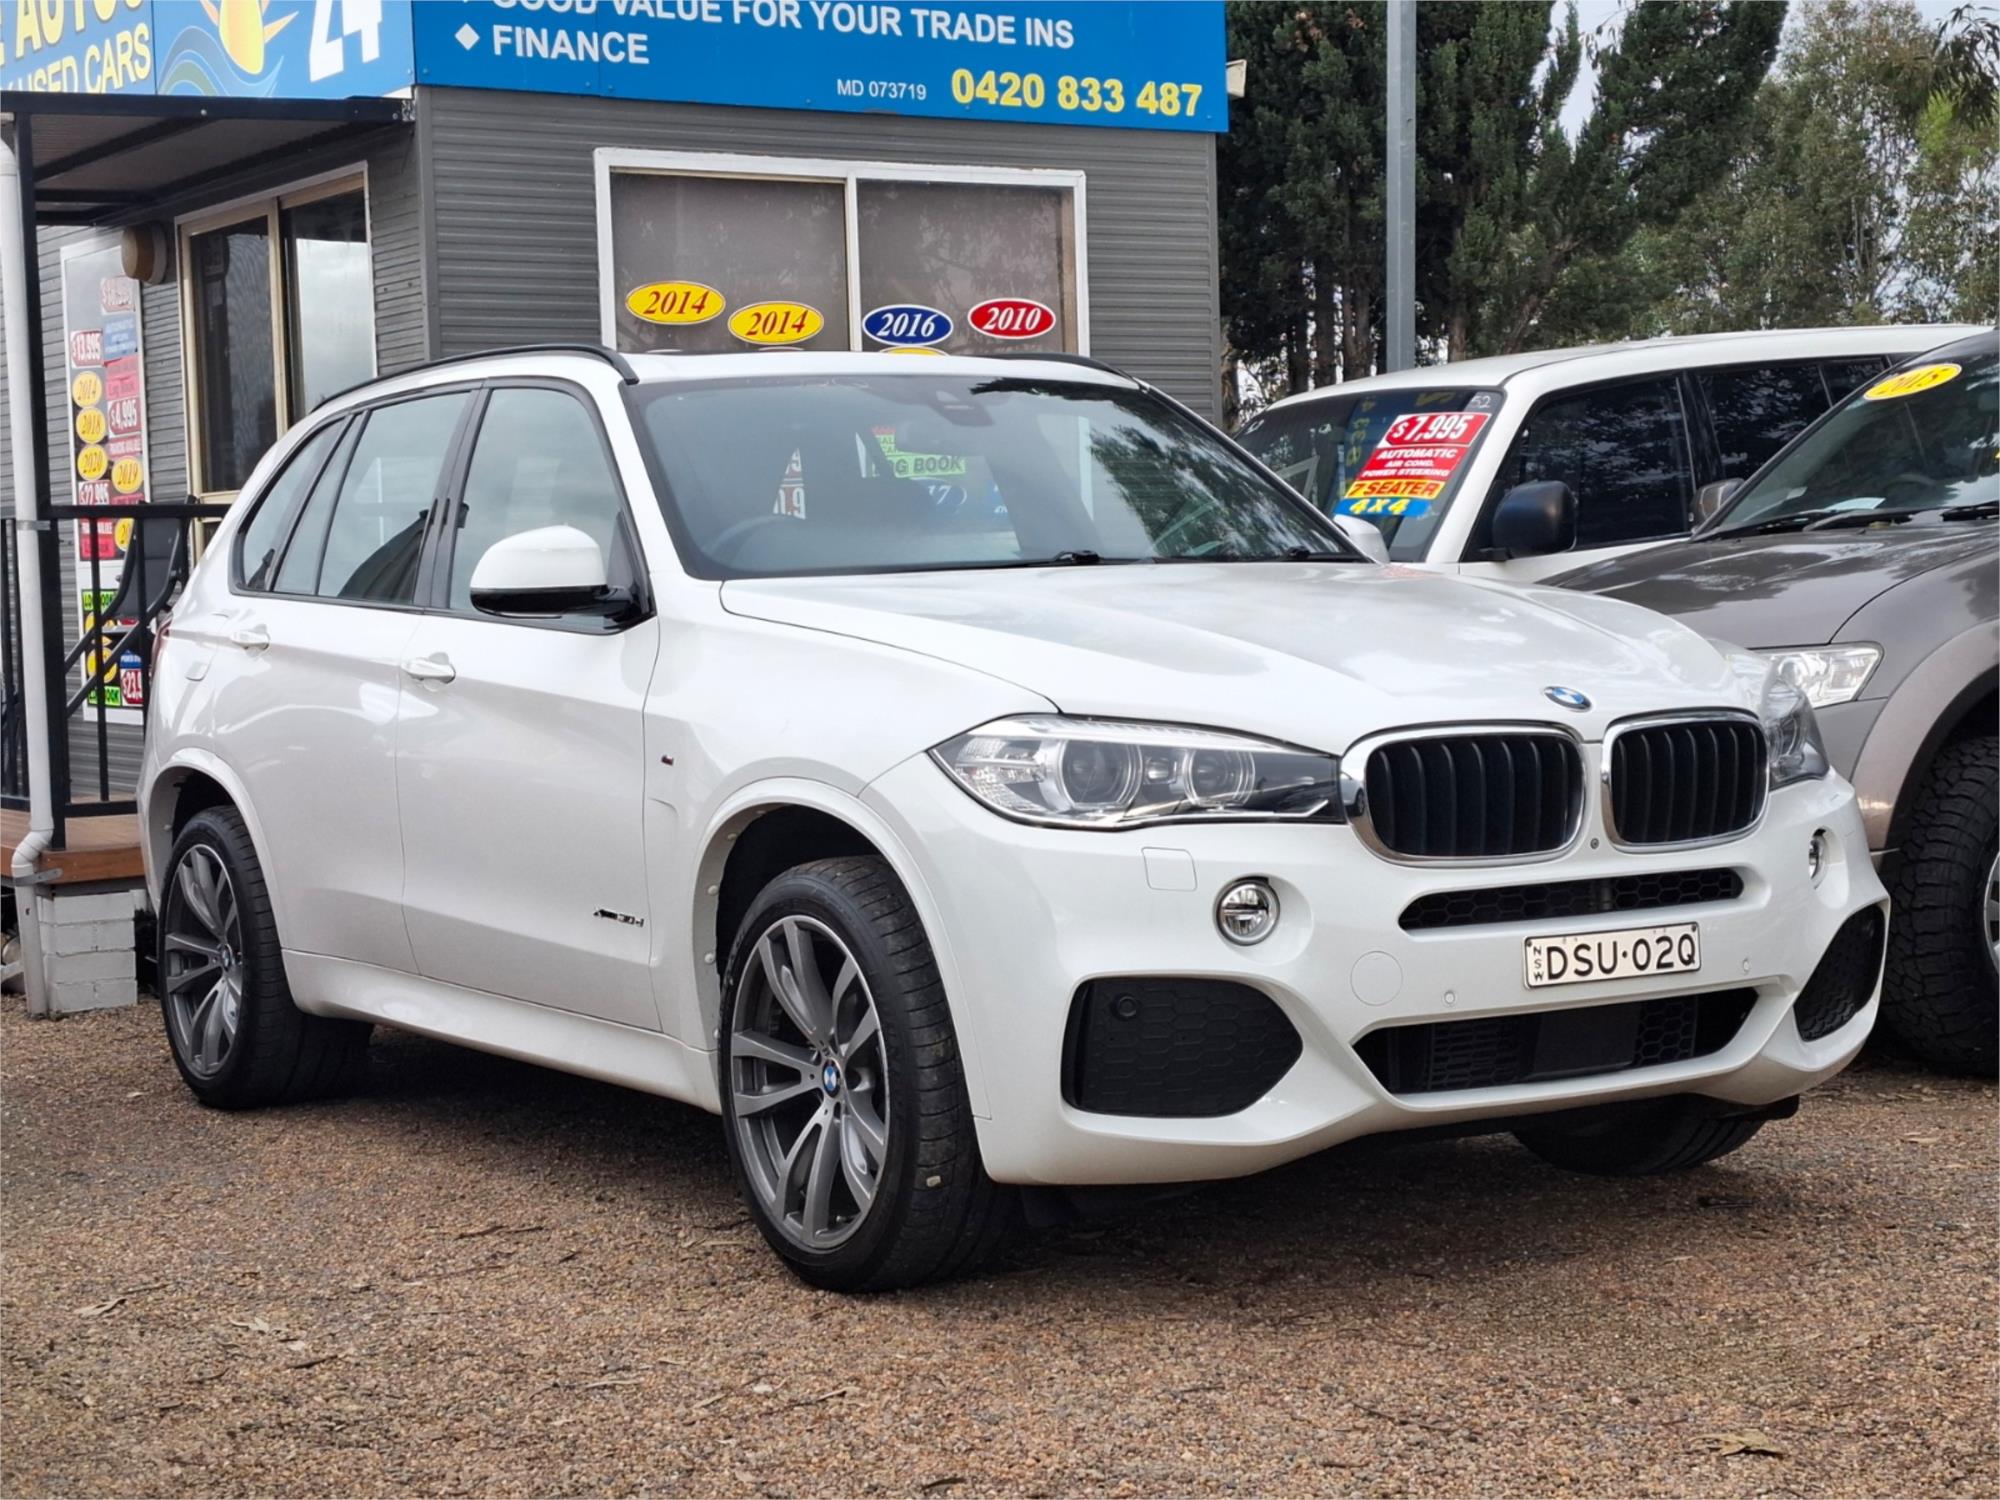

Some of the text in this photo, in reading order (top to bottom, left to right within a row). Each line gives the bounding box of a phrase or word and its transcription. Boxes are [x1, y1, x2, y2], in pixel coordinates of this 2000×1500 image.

[16, 0, 144, 58] AUT
[612, 0, 723, 23] VALUE
[733, 0, 802, 29] FOR
[809, 1, 902, 36] YOUR
[910, 8, 1016, 44] TRADE
[1025, 17, 1075, 49] INS
[493, 24, 650, 64] FINANCE
[84, 22, 152, 93] CARS
[836, 79, 927, 100] MD 073719
[951, 68, 1203, 116] 0420 833 487
[643, 290, 711, 315] 2014
[745, 309, 809, 336] 2014
[876, 313, 939, 338] 2016
[982, 307, 1042, 331] 2010
[1392, 414, 1474, 441] $7,995
[913, 456, 962, 474] BOOK
[1376, 449, 1458, 460] AUTOMATIC
[1363, 481, 1441, 497] SEATER
